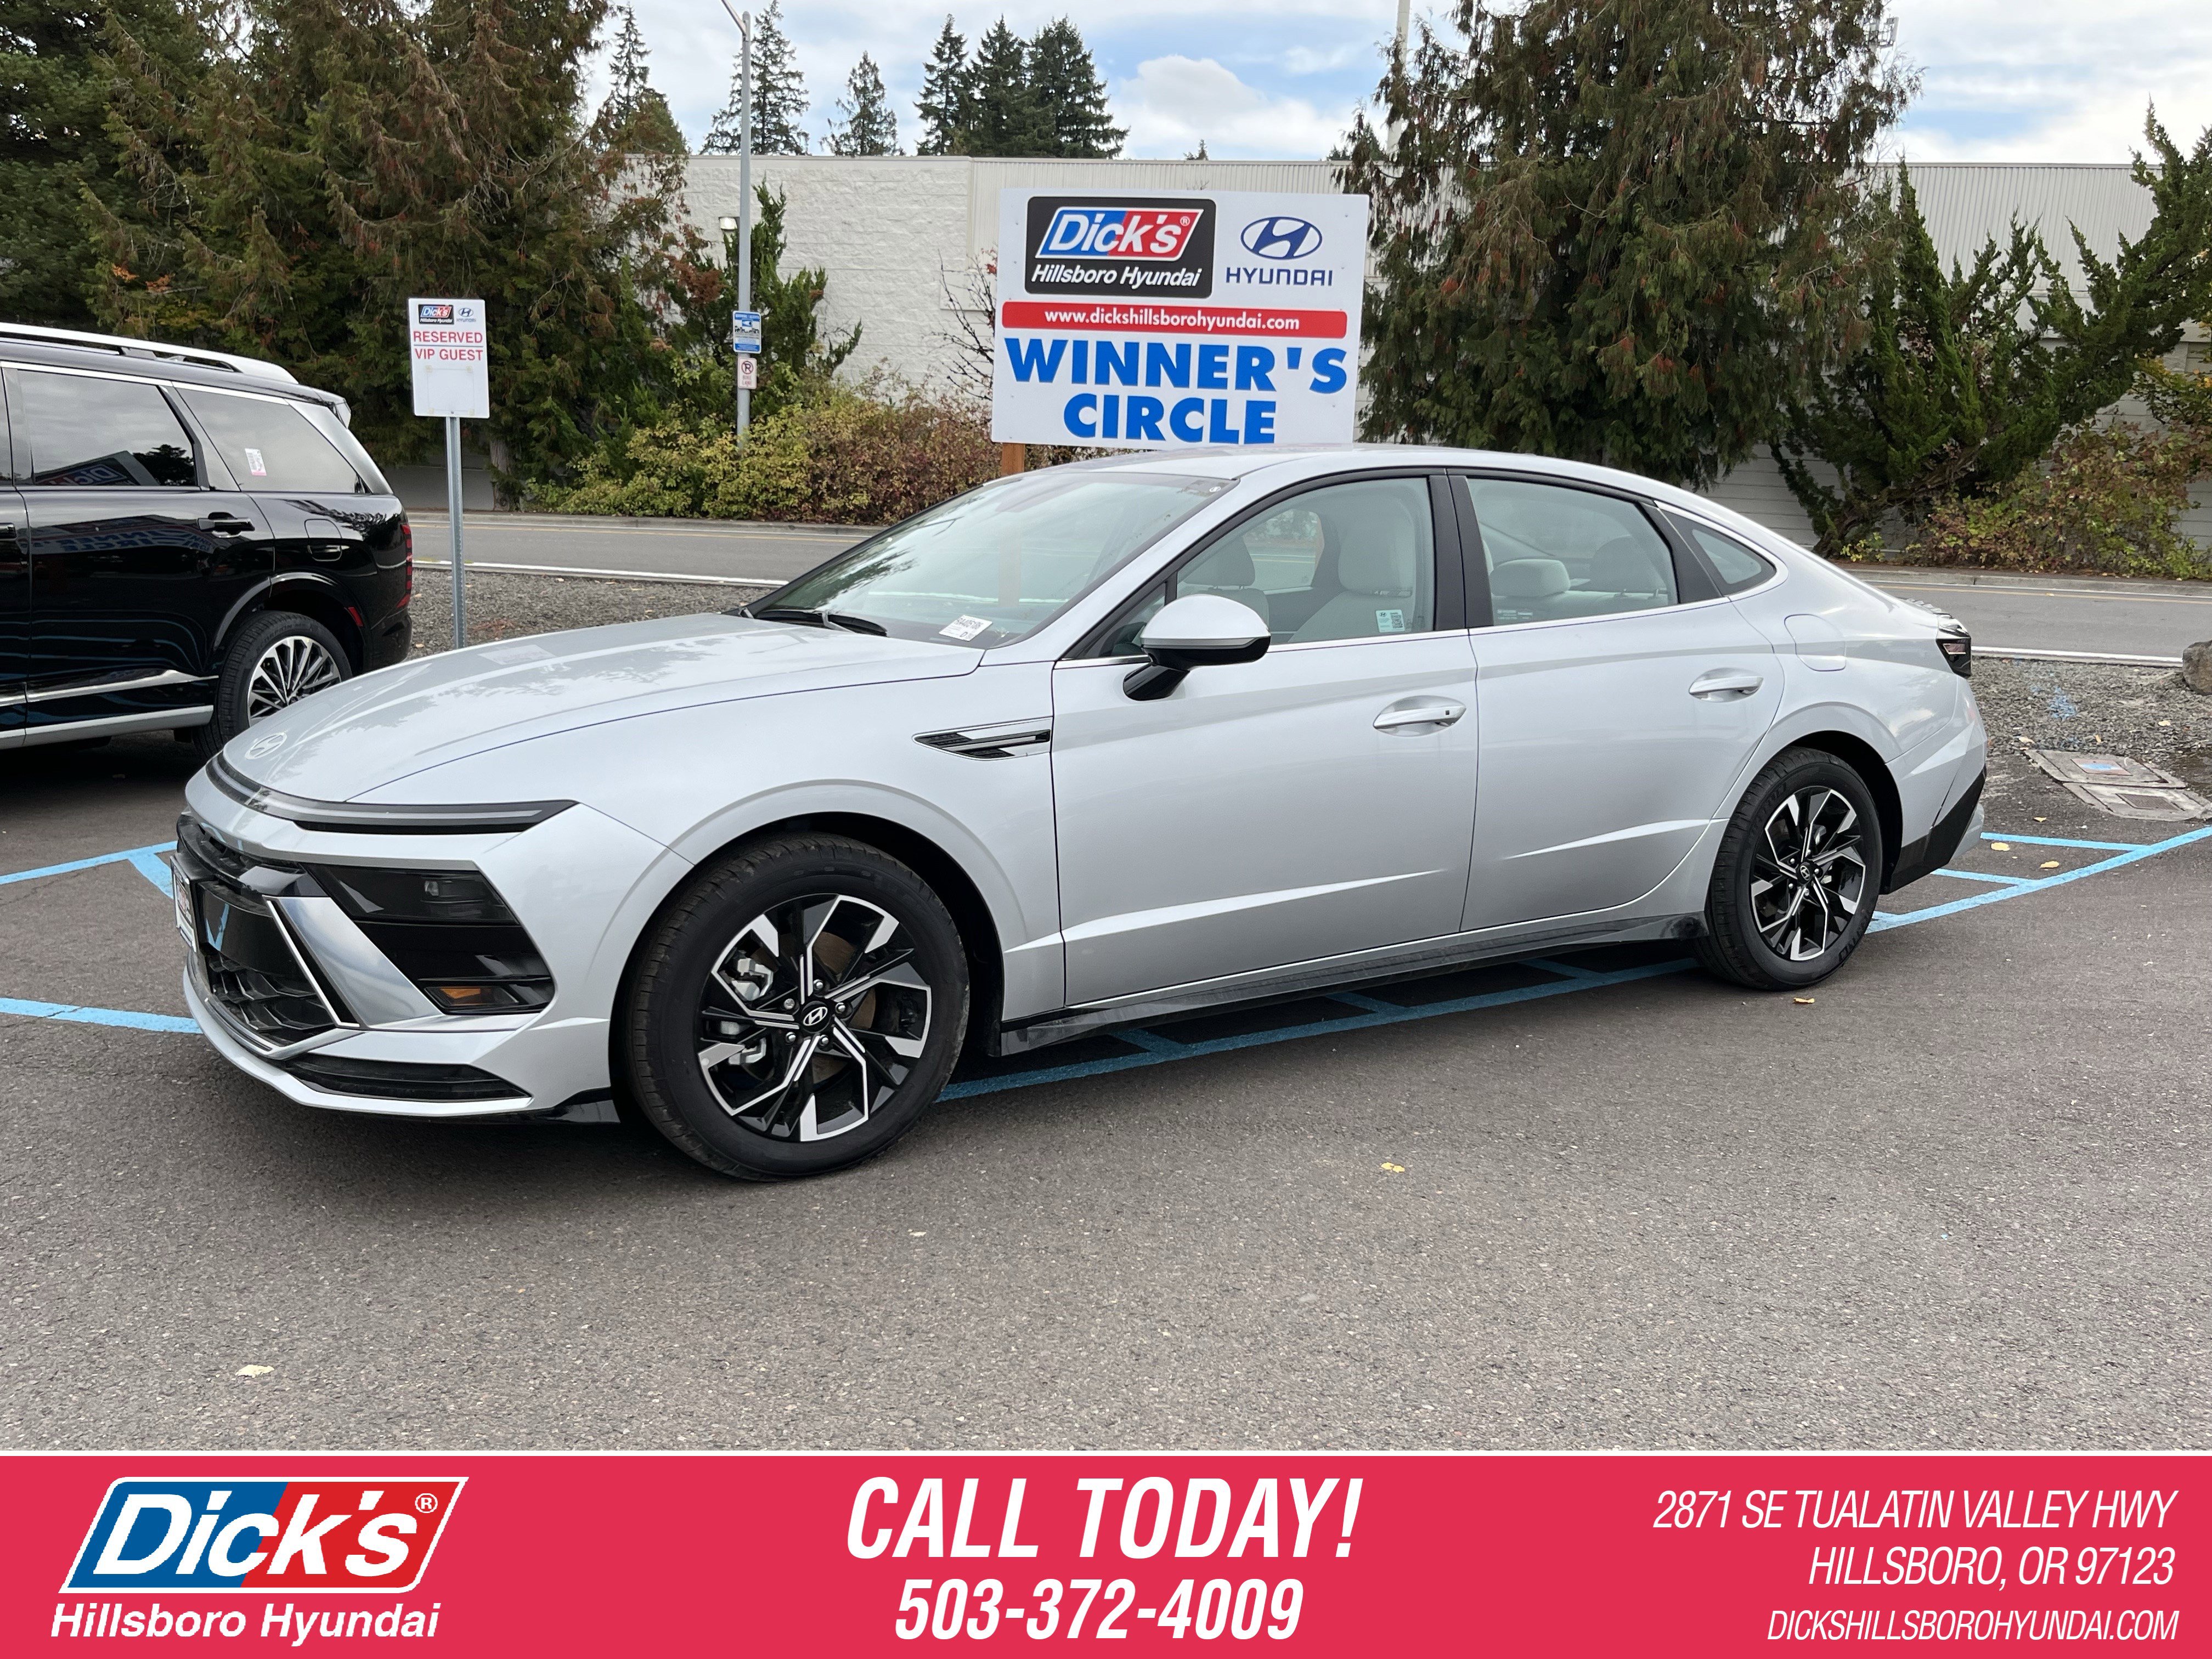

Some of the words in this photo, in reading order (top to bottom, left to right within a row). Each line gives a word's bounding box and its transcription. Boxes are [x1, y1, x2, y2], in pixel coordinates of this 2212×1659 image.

[1049, 213, 1181, 253] Dick's
[1031, 264, 1117, 284] Hillsboro
[1120, 267, 1202, 290] Hyundai
[1227, 267, 1333, 286] HYUNDAI
[1045, 307, 1300, 331] www.dickshillsborohyundai.com
[414, 331, 483, 343] RESERVED
[415, 348, 435, 359] VIP
[439, 348, 483, 360] GUEST
[1005, 338, 1347, 394] WINNER'S
[1064, 393, 1276, 444] CIRCLE
